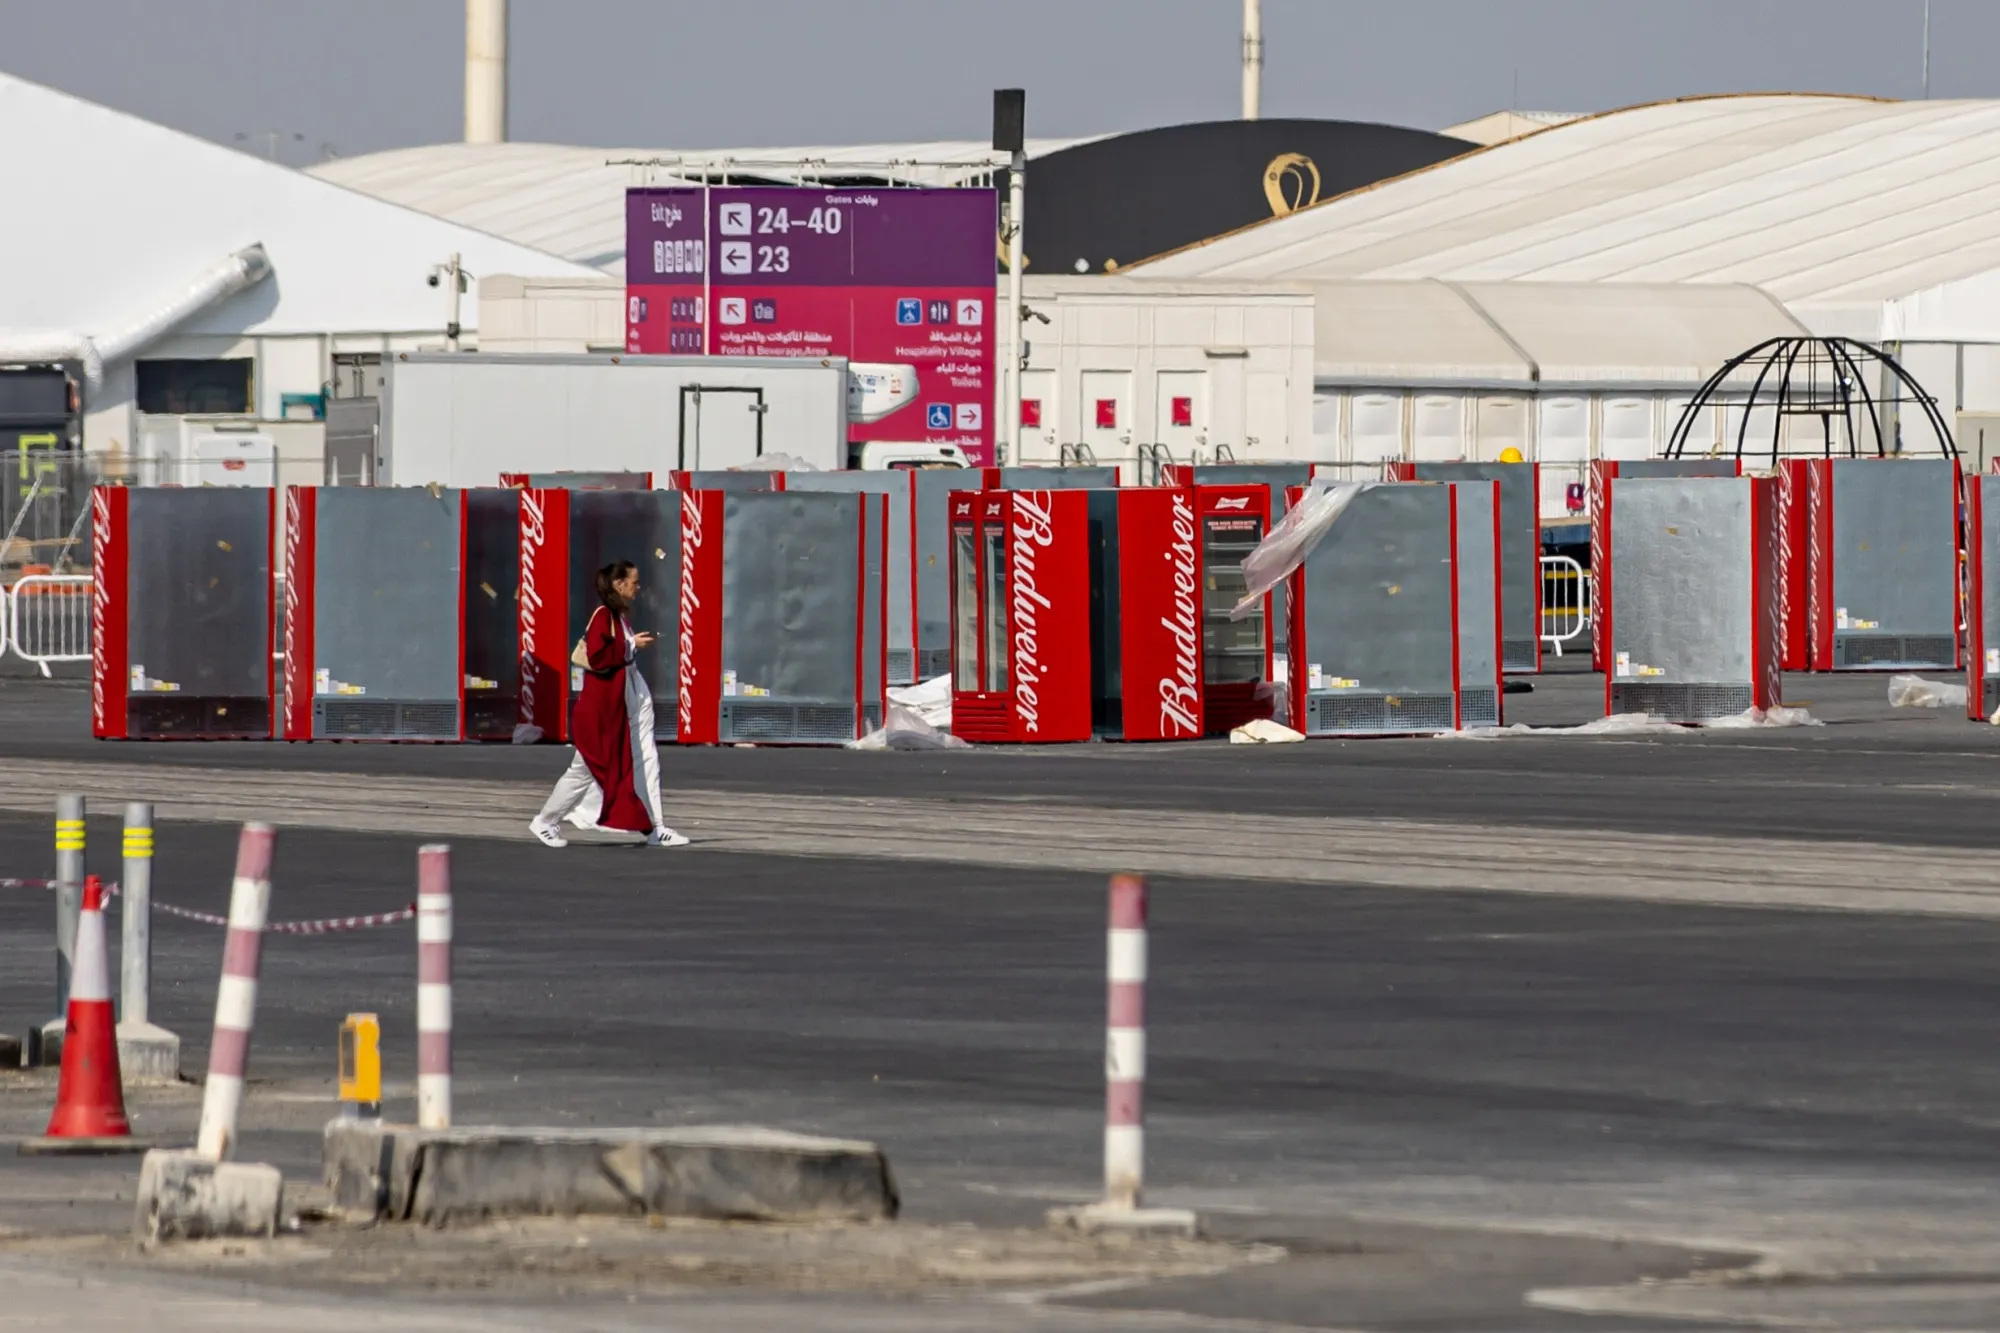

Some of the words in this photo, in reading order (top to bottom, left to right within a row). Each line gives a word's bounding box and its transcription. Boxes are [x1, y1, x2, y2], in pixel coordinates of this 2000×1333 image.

[825, 194, 852, 204] Gates
[651, 203, 665, 222] Exit
[665, 203, 682, 228] مخرج
[757, 245, 790, 273] 23
[903, 301, 916, 309] WC
[720, 345, 745, 355] Food
[747, 345, 755, 355] &
[757, 345, 802, 357] Beverage
[803, 346, 829, 356] Area
[895, 346, 948, 358] Hospitality
[949, 346, 982, 358] Village
[950, 376, 982, 389] Toilets
[1779, 459, 1793, 662] Budweiser
[93, 487, 111, 729] Budweiser
[284, 486, 300, 731] Budweiser
[680, 489, 702, 735] Budweiser
[1013, 490, 1053, 732] Budweiser
[1159, 494, 1199, 737] Budweiser
